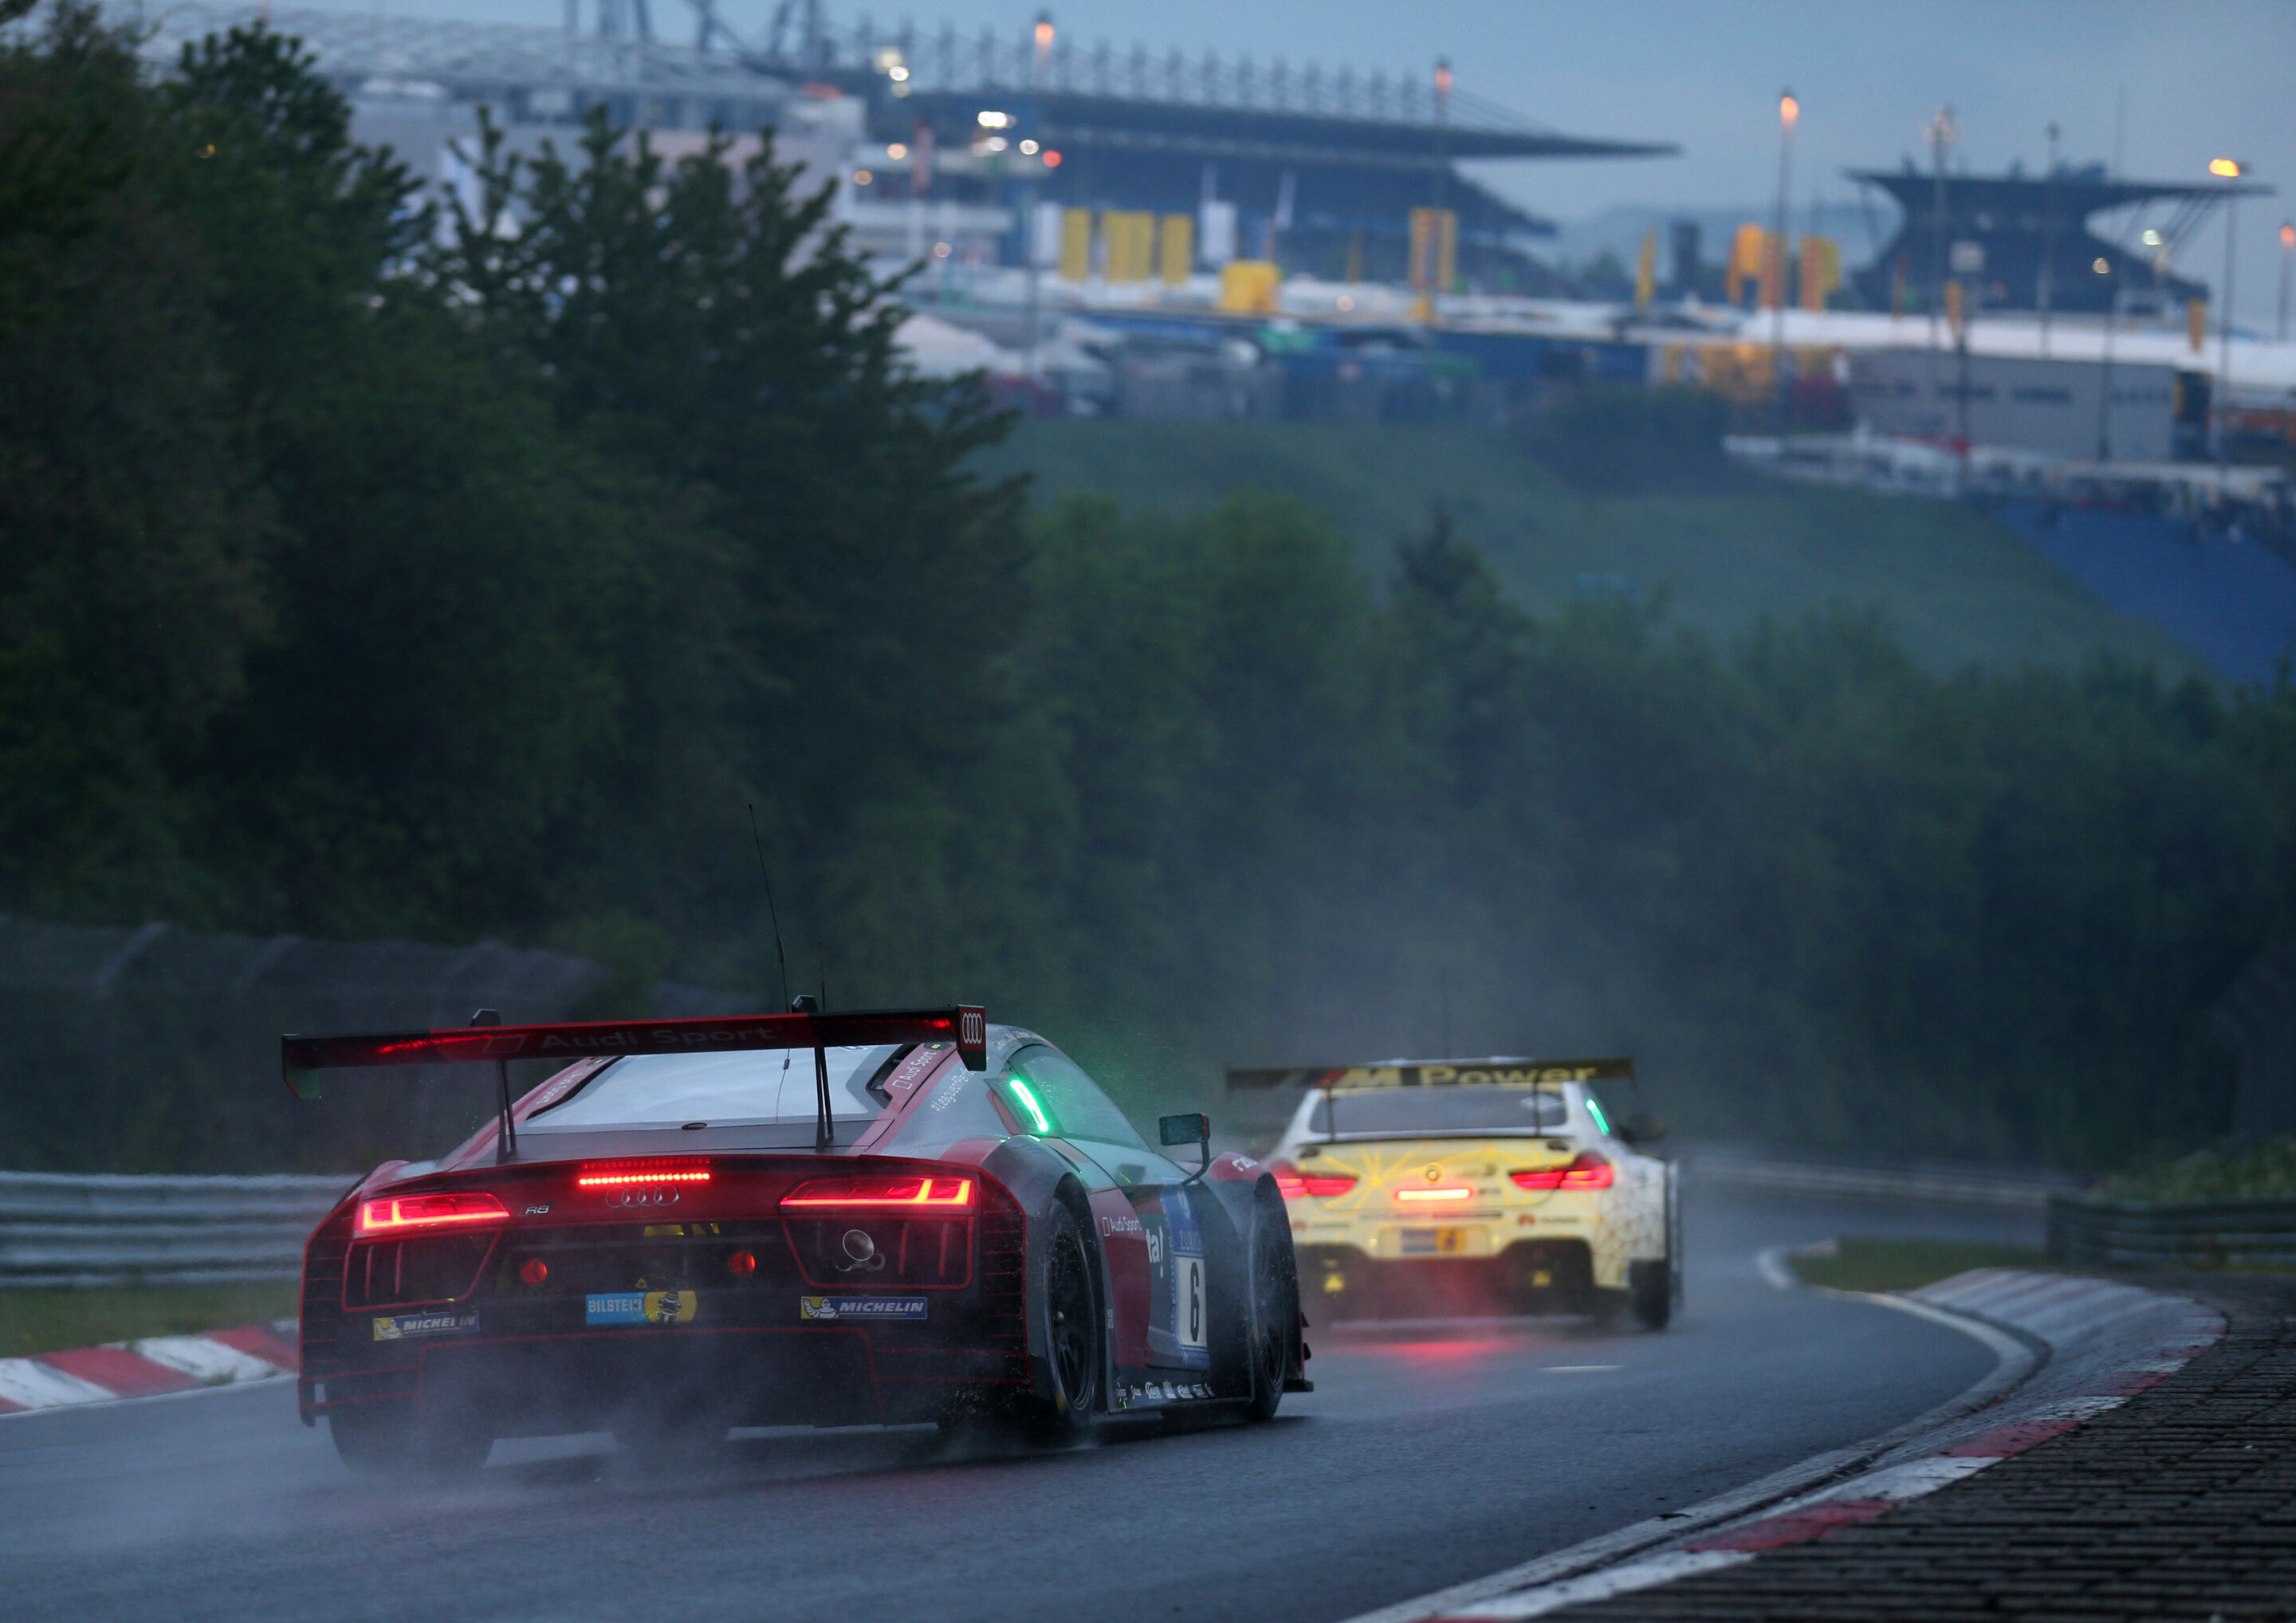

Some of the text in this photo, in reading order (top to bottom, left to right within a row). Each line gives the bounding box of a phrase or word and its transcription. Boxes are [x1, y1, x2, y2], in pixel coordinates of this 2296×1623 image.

[539, 1025, 778, 1049] Audi Sport
[1417, 1064, 1598, 1087] Power
[525, 1204, 551, 1216] R8
[588, 1298, 643, 1314] BILSTEIN
[839, 1301, 925, 1313] MICHELIN
[1189, 1261, 1200, 1342] 6
[403, 1315, 477, 1330] MICHELIN
